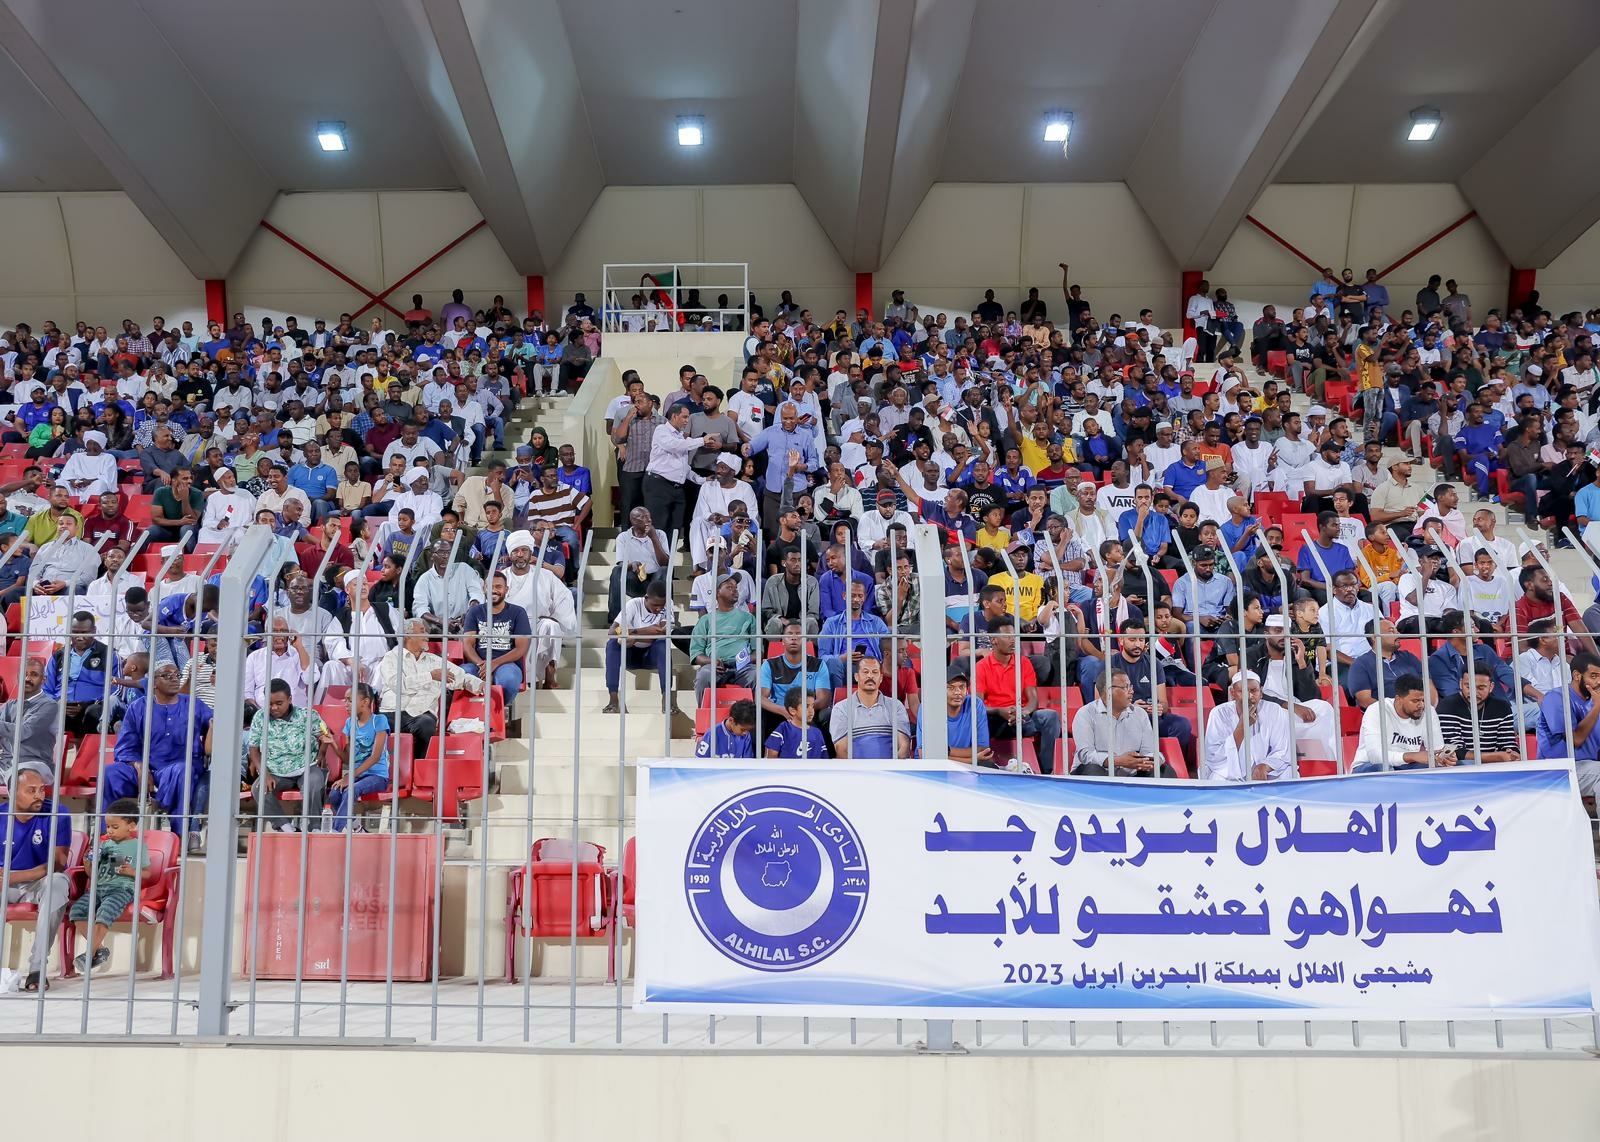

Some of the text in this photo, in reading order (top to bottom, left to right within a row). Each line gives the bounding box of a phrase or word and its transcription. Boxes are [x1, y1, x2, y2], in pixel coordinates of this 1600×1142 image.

[1107, 495, 1136, 508] VANS
[770, 824, 783, 839] الله
[924, 801, 1497, 867] نحن الهلال بنريدو جد
[754, 841, 799, 858] الوطن الهلال
[689, 874, 710, 885] 1930
[925, 872, 1060, 949] للأبد
[1073, 883, 1271, 949] نعشقو
[724, 932, 831, 962] ALHILAL S.C.
[1003, 961, 1433, 994] مشجعي الهلال بمملكة البحرين ابريل 2023
